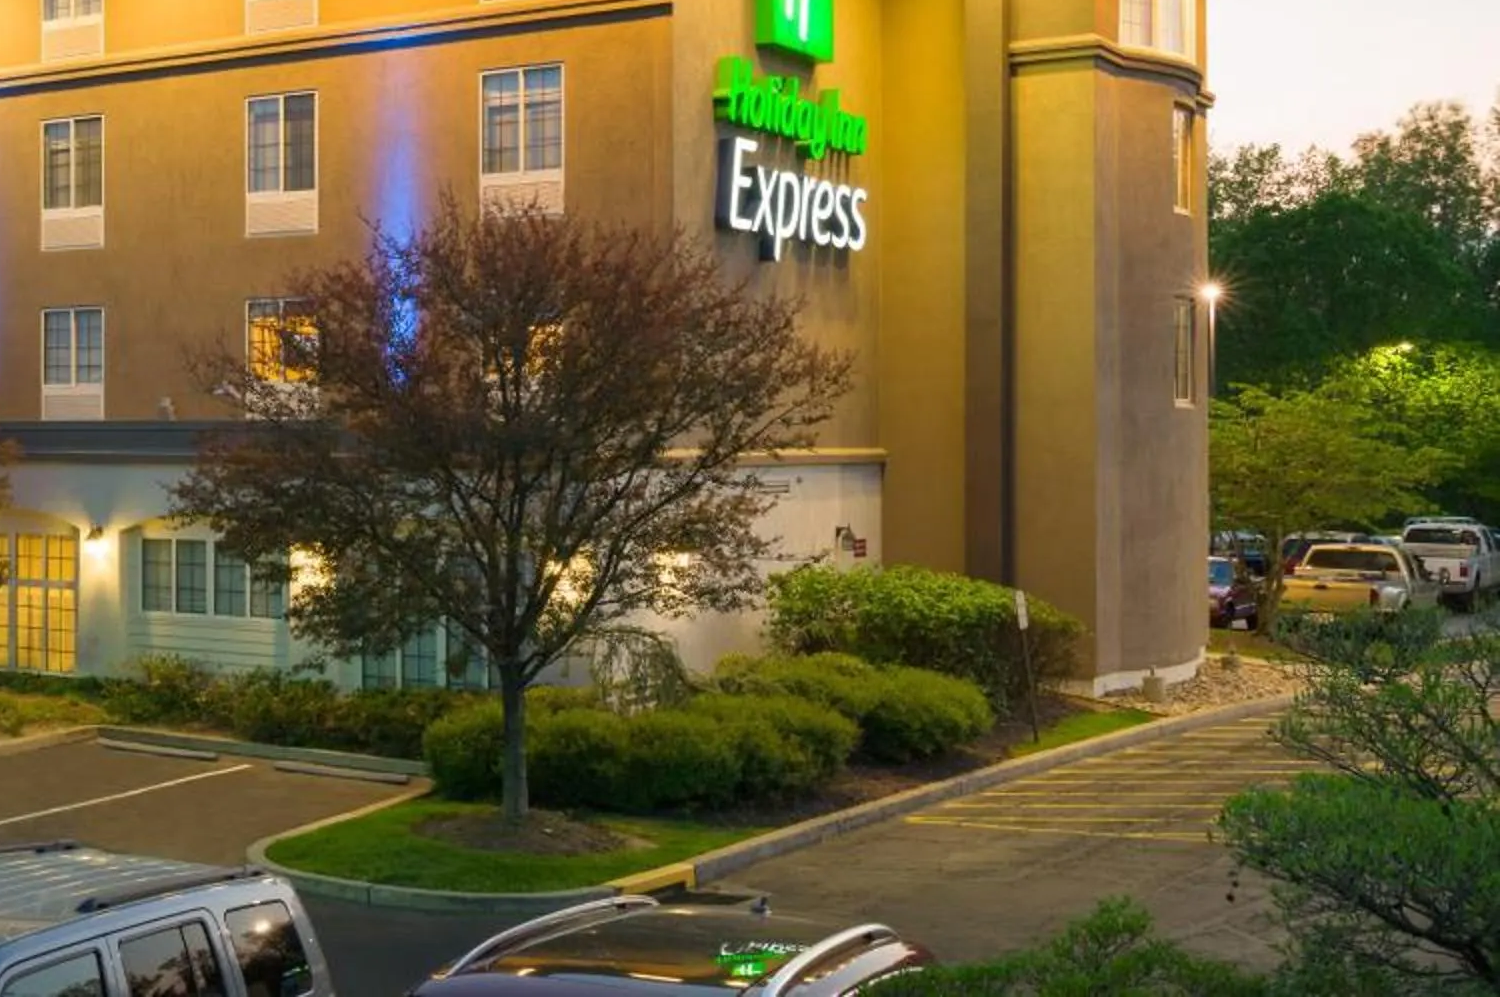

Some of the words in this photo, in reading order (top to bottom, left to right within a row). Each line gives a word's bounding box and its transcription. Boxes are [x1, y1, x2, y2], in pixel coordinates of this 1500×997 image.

[725, 56, 828, 161] Holiday
[830, 89, 868, 156] Inn
[729, 136, 868, 263] Express
